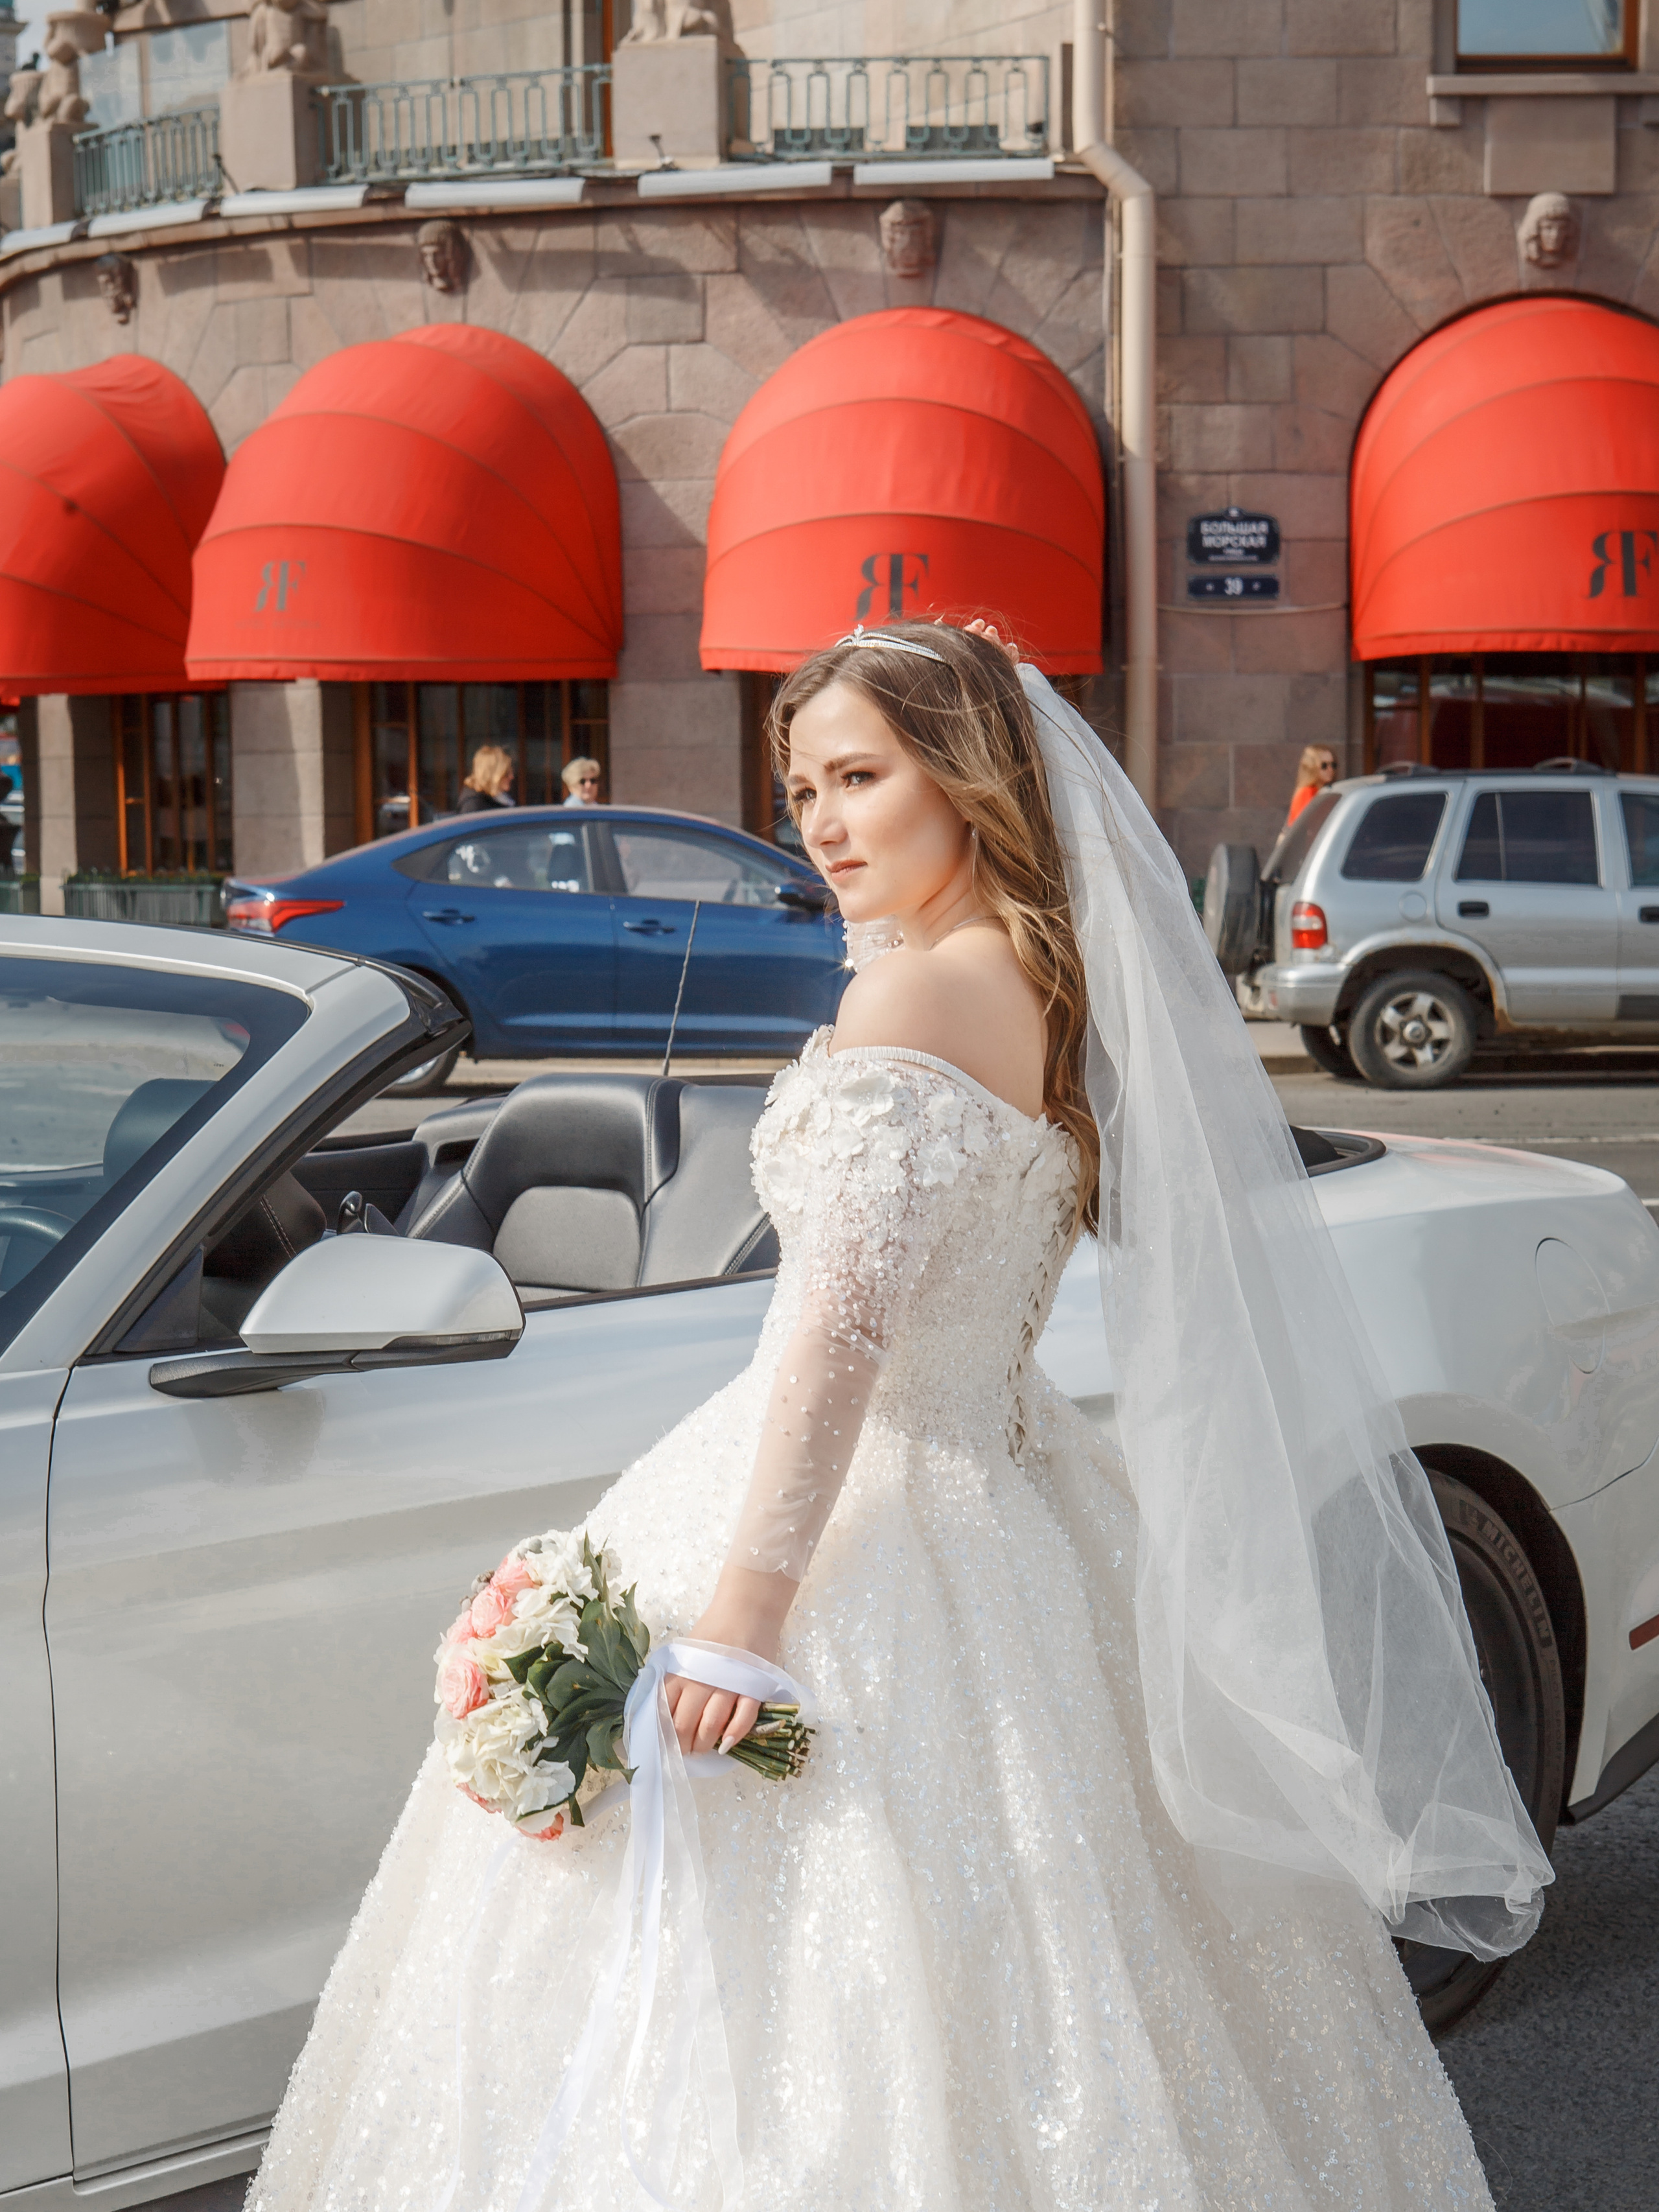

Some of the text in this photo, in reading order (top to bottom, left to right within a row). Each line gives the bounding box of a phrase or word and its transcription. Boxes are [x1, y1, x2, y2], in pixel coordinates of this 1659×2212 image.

[1201, 521, 1269, 535] БОЛЬШАЯ
[1202, 535, 1267, 548] МОРСКАЯ
[1479, 1520, 1549, 1638] MICHELIN
